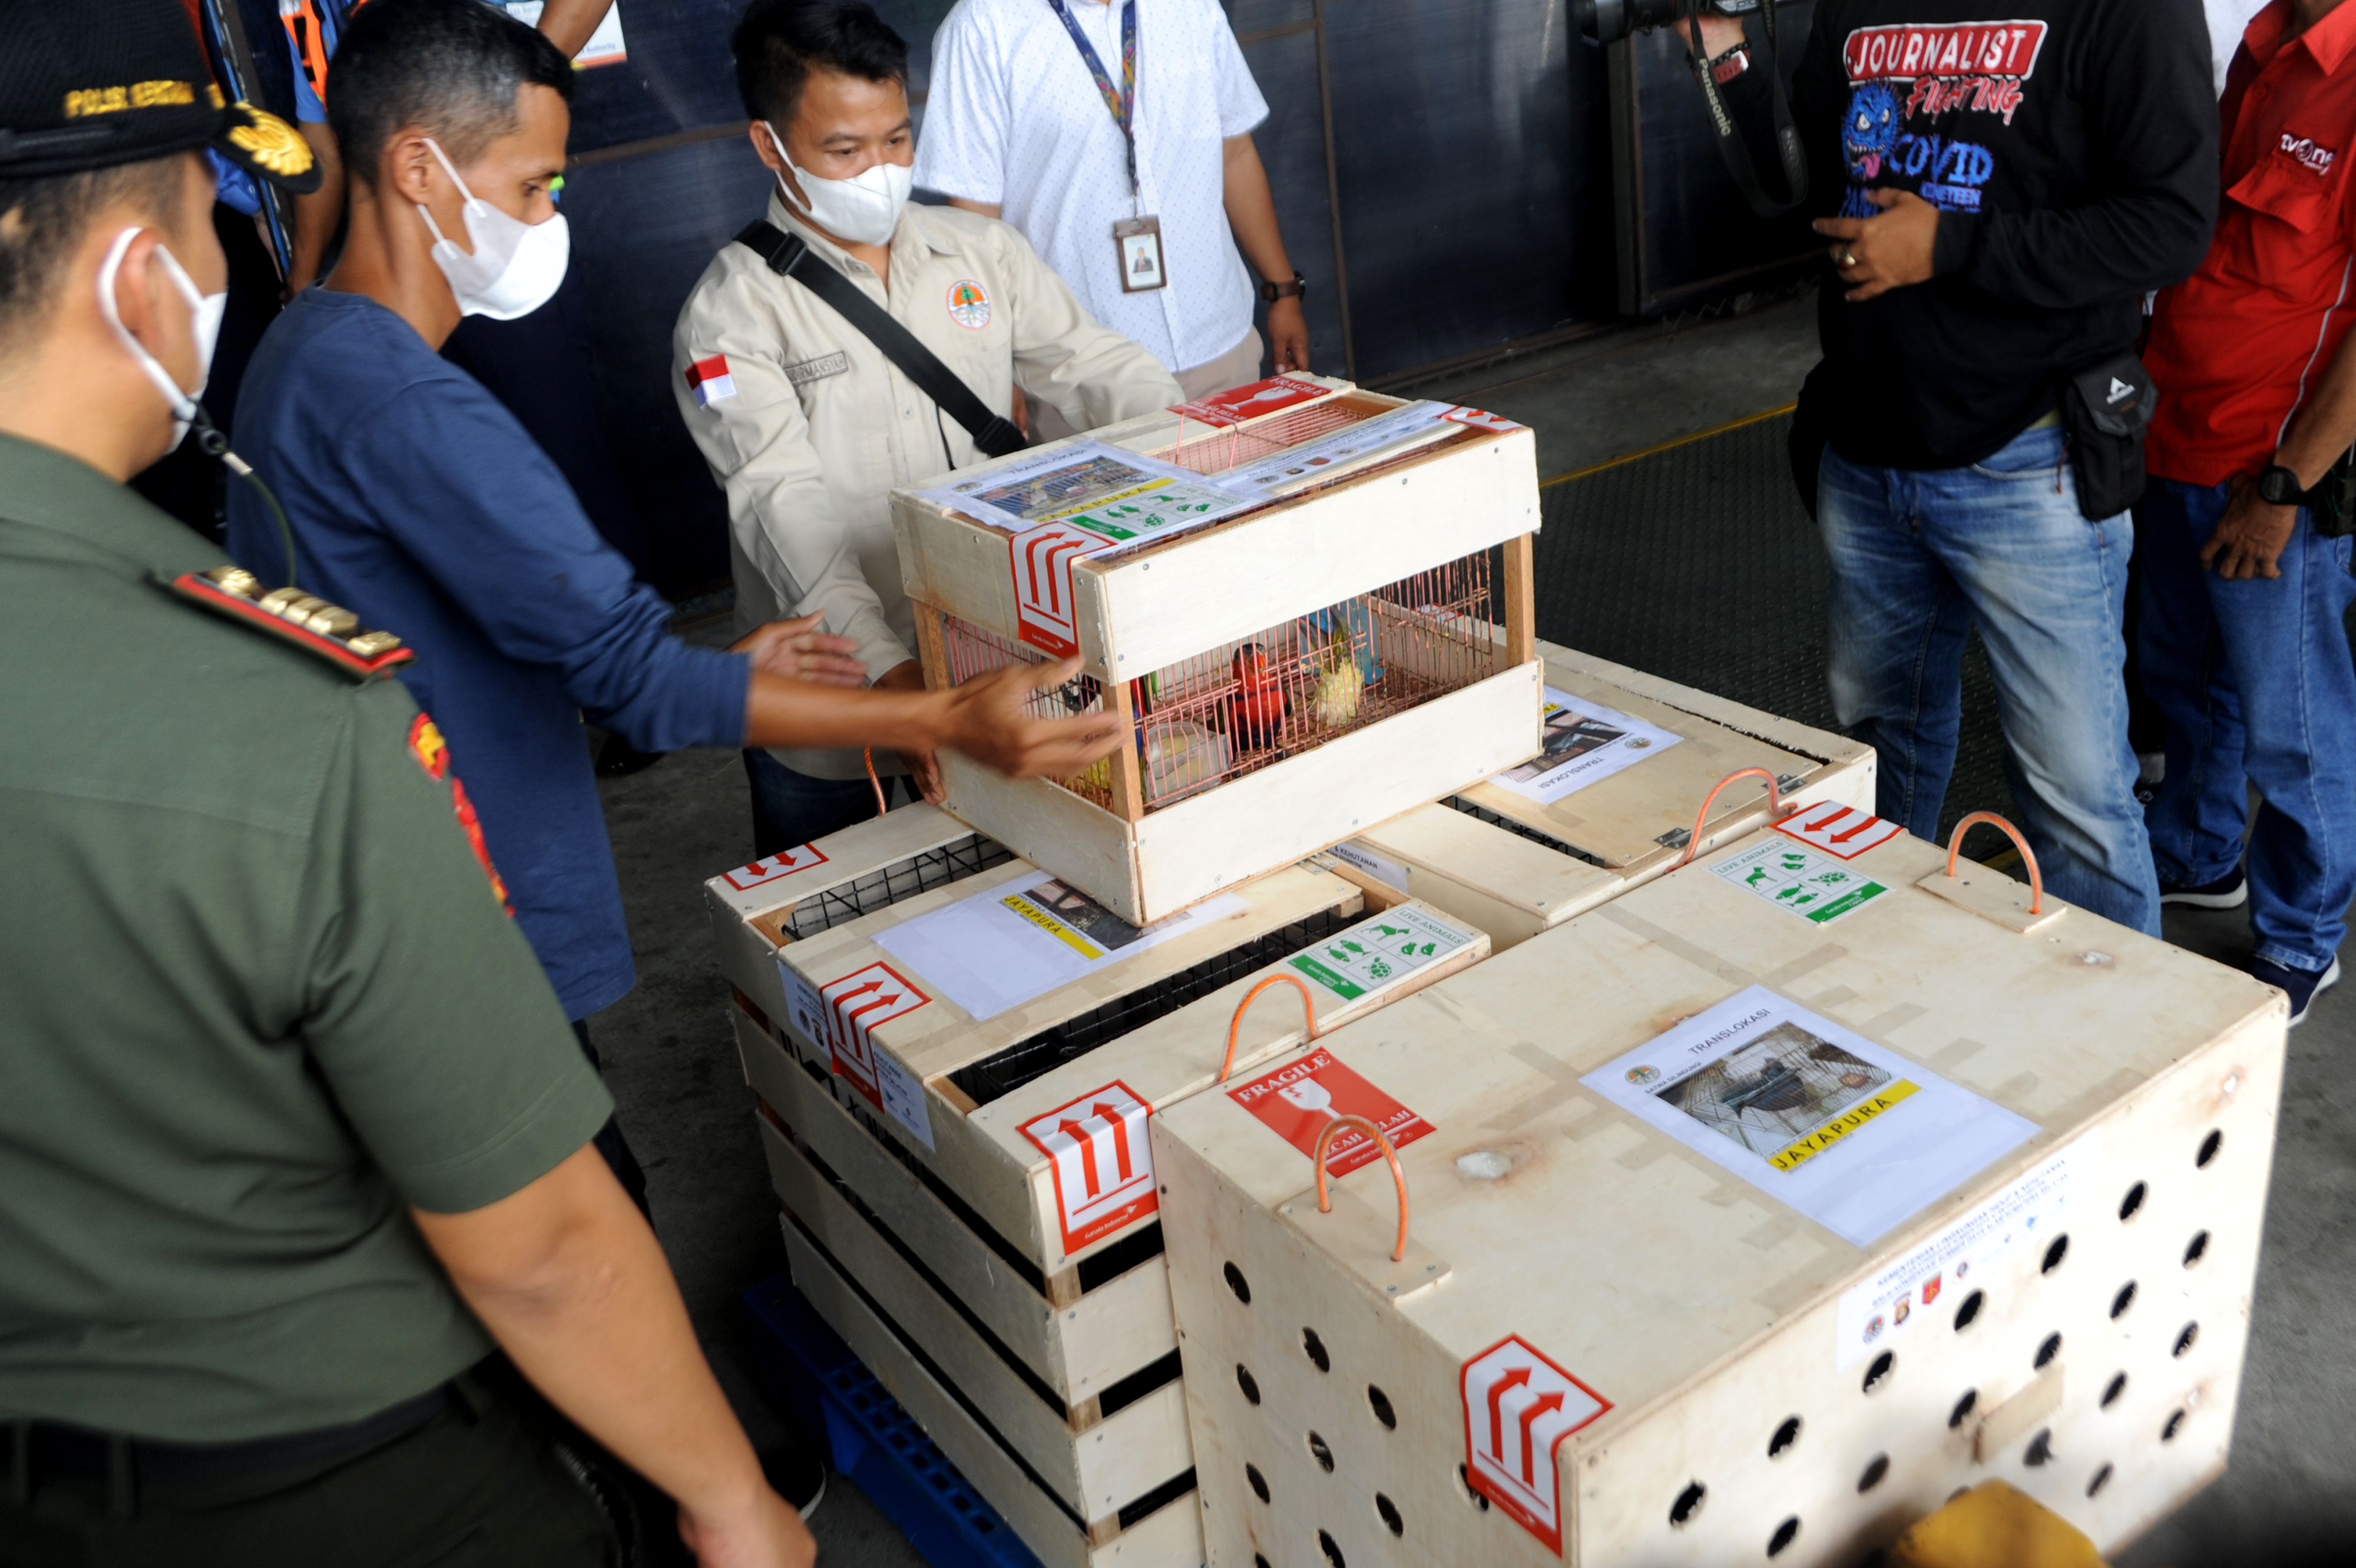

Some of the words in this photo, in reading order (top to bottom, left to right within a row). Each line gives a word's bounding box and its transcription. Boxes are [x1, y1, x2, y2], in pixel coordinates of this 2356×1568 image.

[1854, 28, 2028, 75] JOURNALIST
[1699, 58, 1732, 137] Panasonic
[1905, 75, 2024, 125] FIGHTING
[1889, 133, 1994, 186] COVID
[1269, 377, 1326, 395] FRAGILE
[1010, 449, 1087, 474] TRANSLOKASI
[1537, 756, 1606, 789] TRANSLOKASI
[1339, 848, 1378, 869] KEHUTANAN
[1717, 861, 1740, 874] LIVE
[1741, 841, 1784, 864] ANIMALS
[1005, 896, 1061, 933] JAYAPURA
[1399, 910, 1420, 924] LIVE
[1419, 921, 1463, 944] ANIMALS
[1687, 1008, 1771, 1055] TRANSLOKASI
[1237, 1054, 1332, 1103] FRAGILE
[1644, 1079, 1667, 1094] SATWA
[1667, 1061, 1702, 1083] DILINDUNGI
[1775, 1097, 1892, 1169] JAYAPURA
[1085, 1226, 1104, 1238] Garuda
